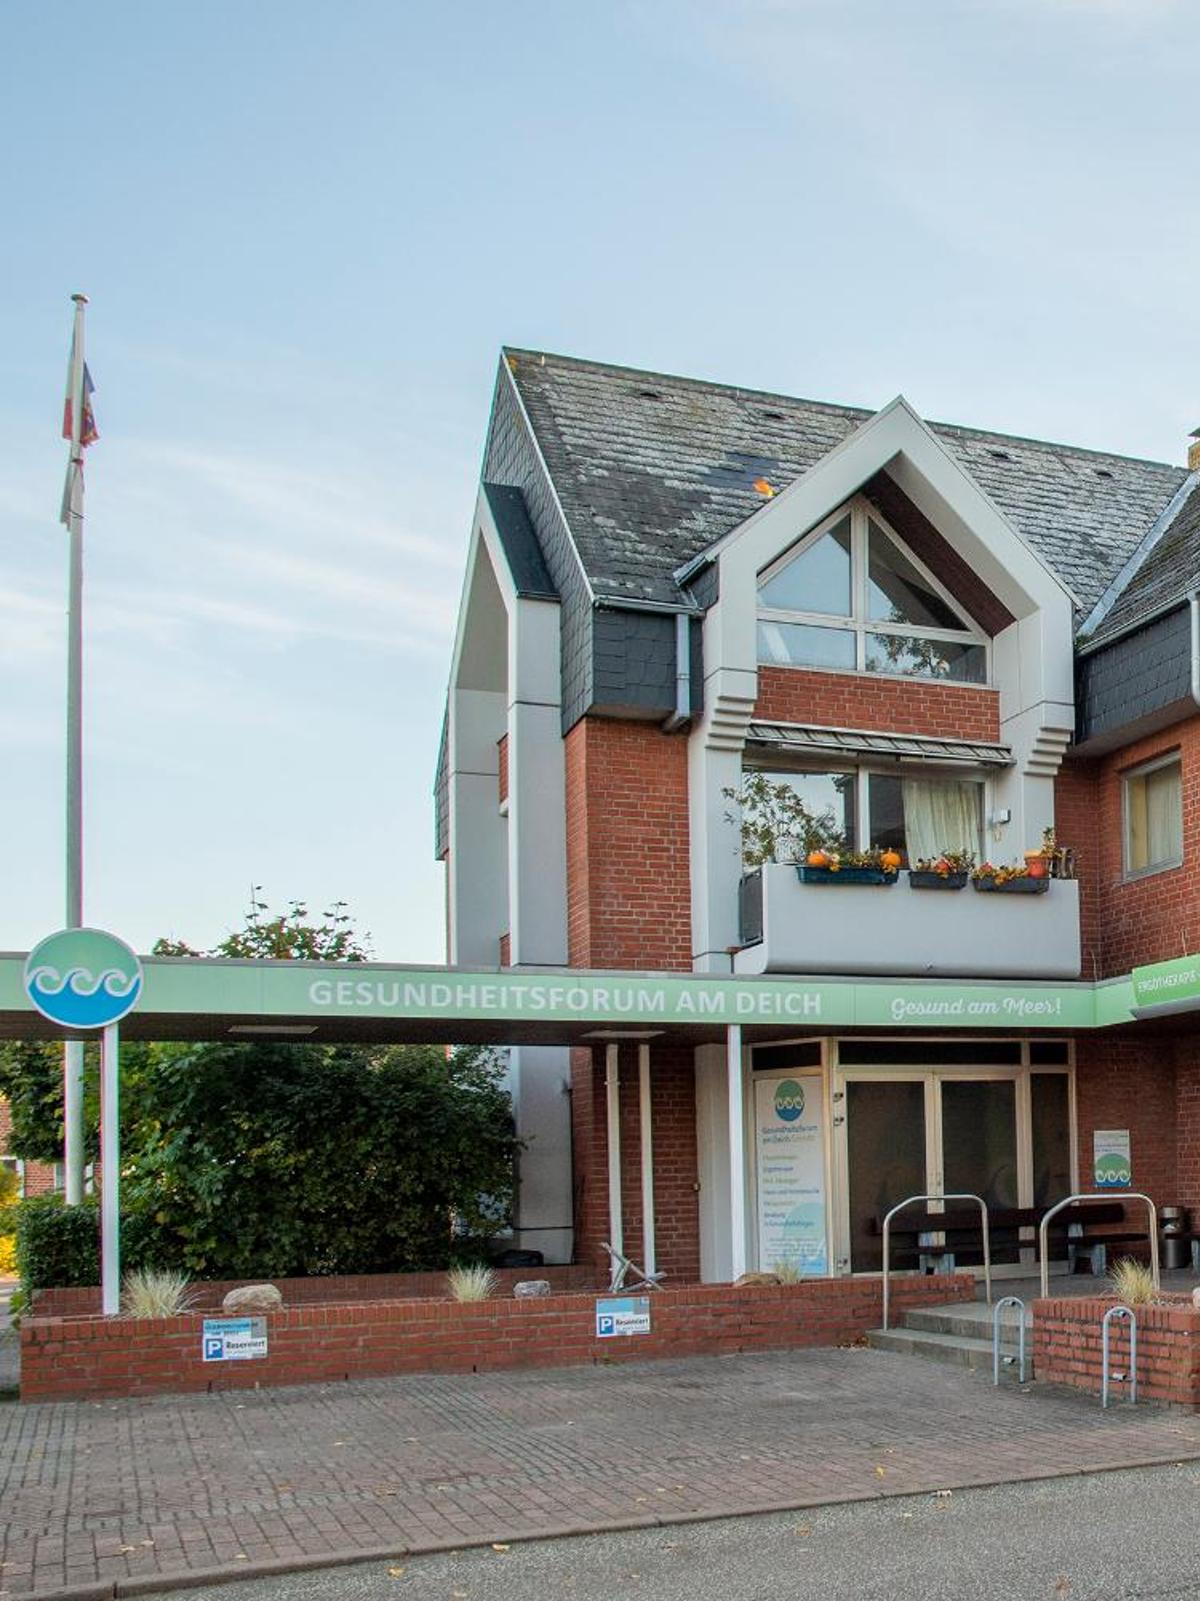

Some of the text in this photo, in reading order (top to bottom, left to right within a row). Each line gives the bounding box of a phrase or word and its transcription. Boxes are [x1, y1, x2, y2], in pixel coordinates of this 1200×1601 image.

[1138, 970, 1196, 993] ERGOTHERAPIE
[308, 980, 822, 1015] GESUNDHEITSFORUM AM DEICH
[891, 997, 1062, 1021] Gesund am Meer!
